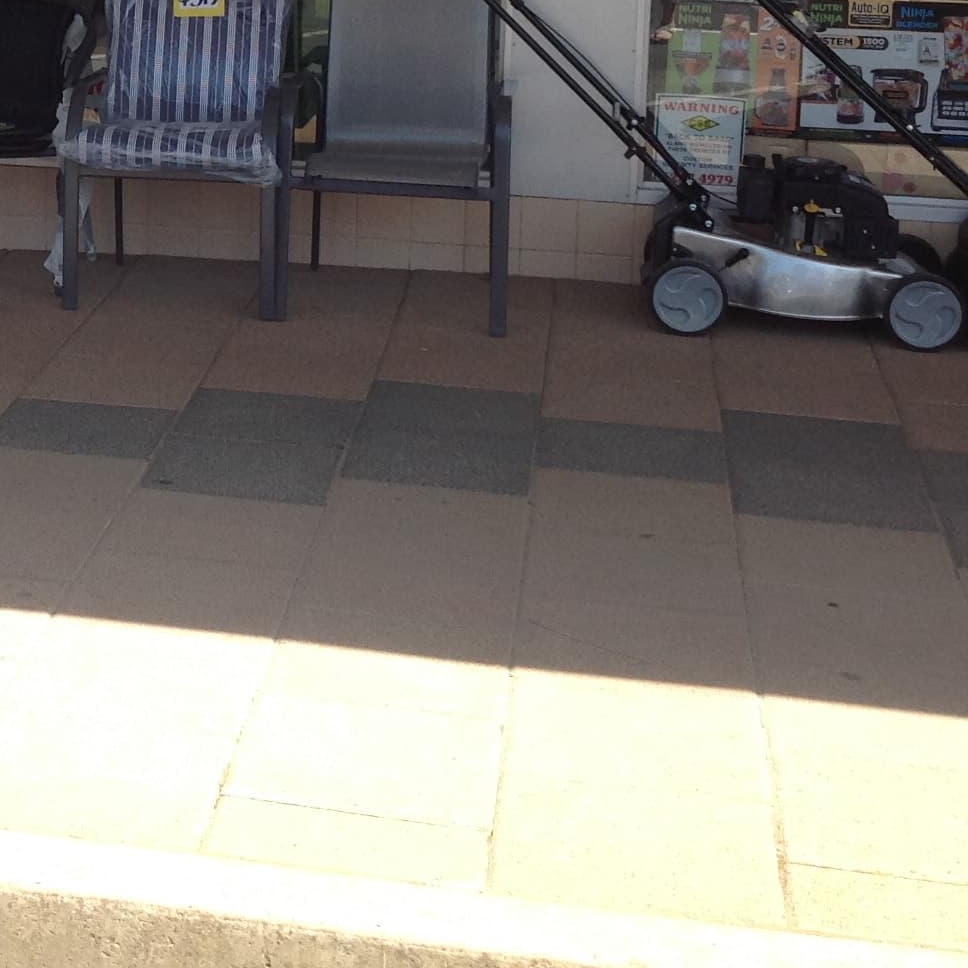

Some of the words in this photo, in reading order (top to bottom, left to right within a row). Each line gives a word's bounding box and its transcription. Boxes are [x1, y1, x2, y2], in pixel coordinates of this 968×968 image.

[679, 5, 712, 14] NUTRI
[811, 2, 844, 12] NUTRI
[900, 6, 935, 19] NINJA
[679, 14, 712, 26] NINJA
[811, 12, 843, 25] NINJA
[664, 101, 740, 115] WARNING
